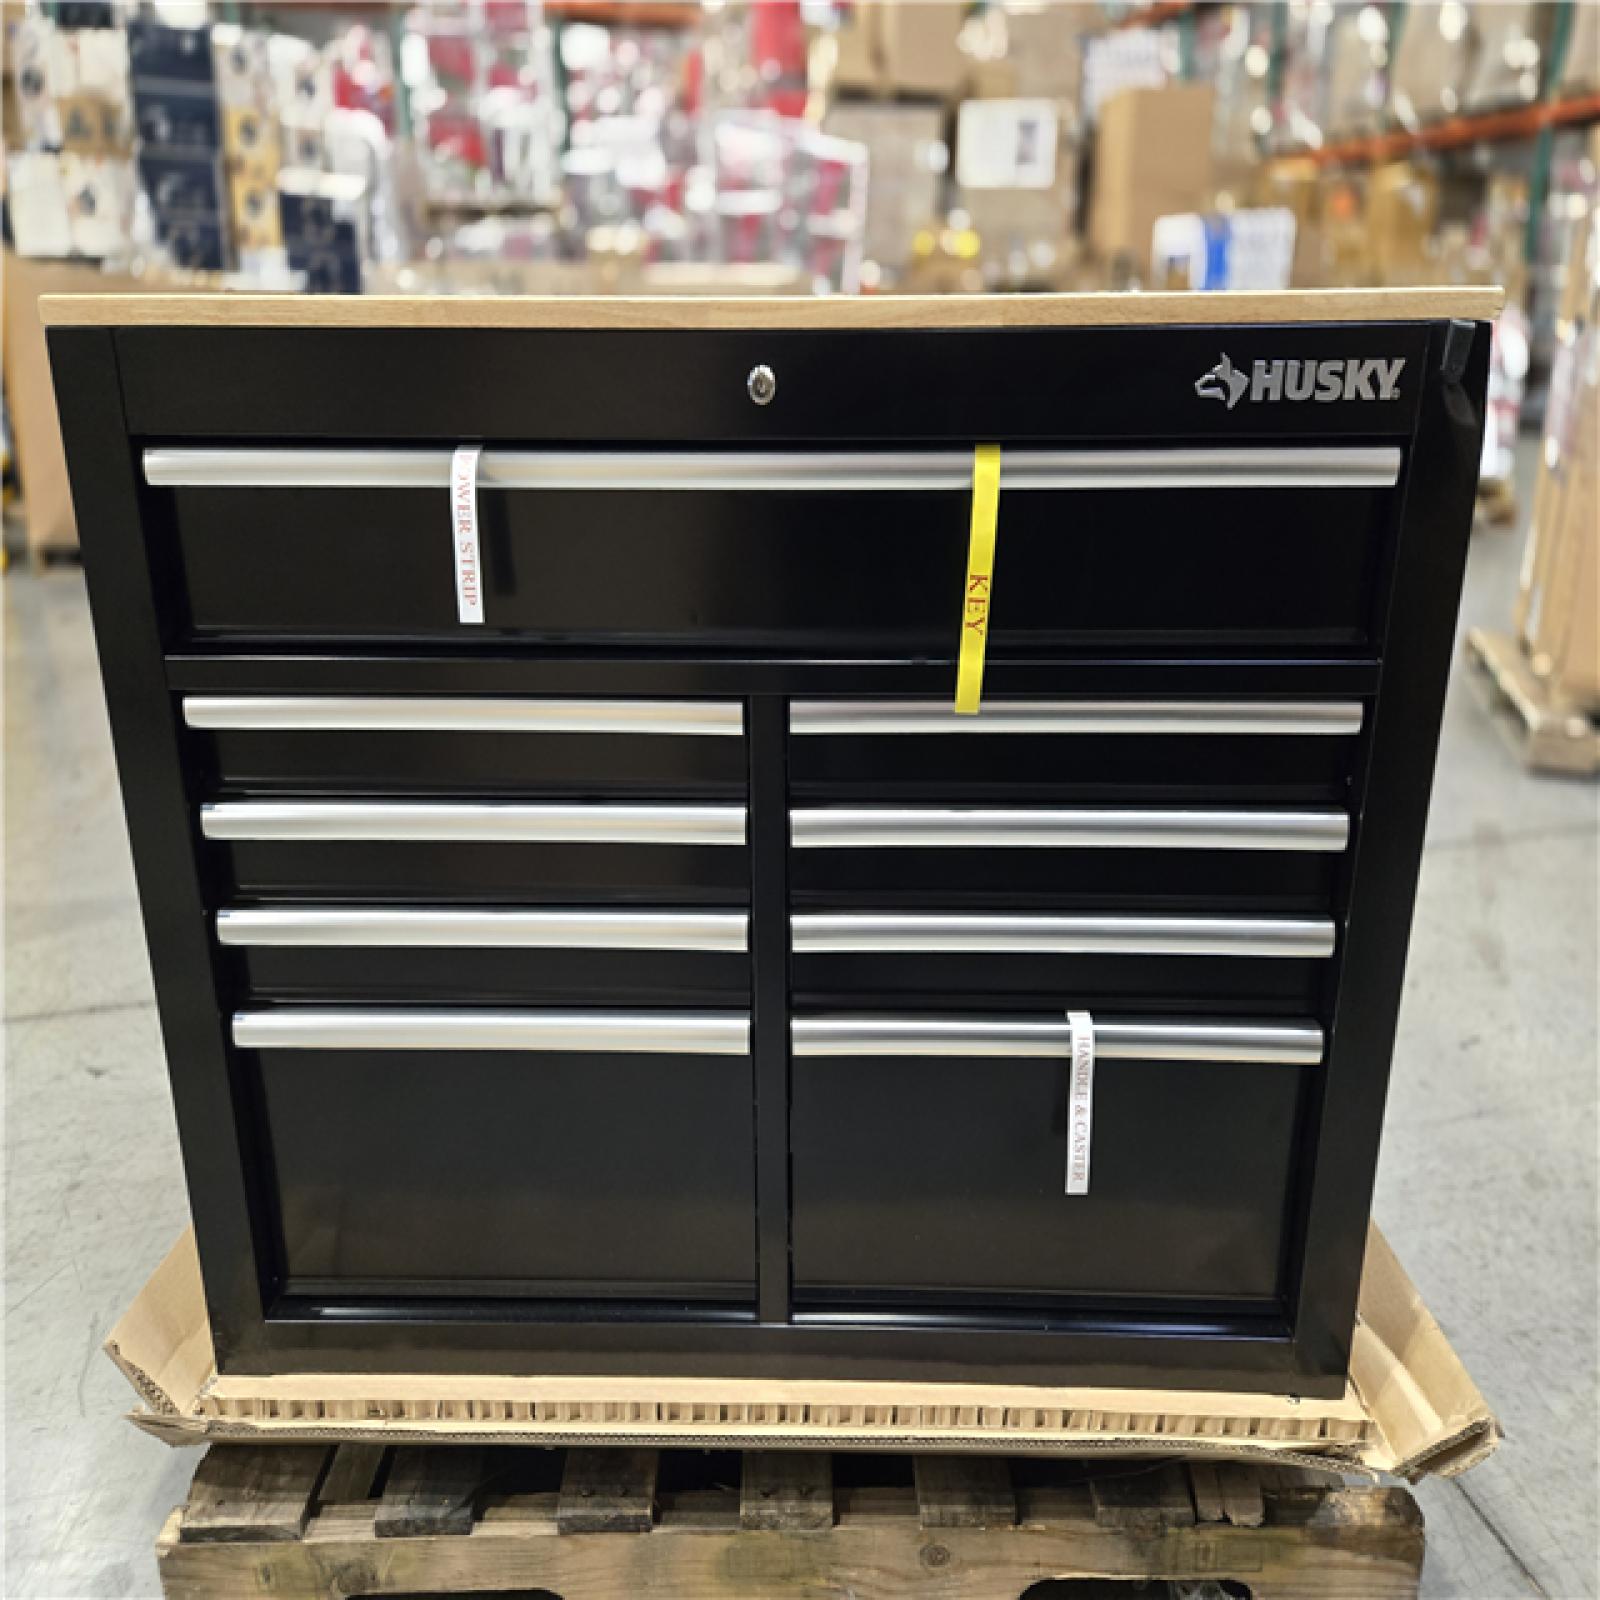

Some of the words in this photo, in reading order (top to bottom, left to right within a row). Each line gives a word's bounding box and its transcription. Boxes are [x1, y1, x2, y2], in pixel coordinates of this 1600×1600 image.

[1252, 359, 1406, 401] HUSKY
[460, 542, 476, 606] STRIP
[964, 574, 988, 635] KEY
[1075, 1036, 1091, 1101] HANDLE
[1074, 1104, 1087, 1117] &
[1073, 1121, 1088, 1181] CASTER
